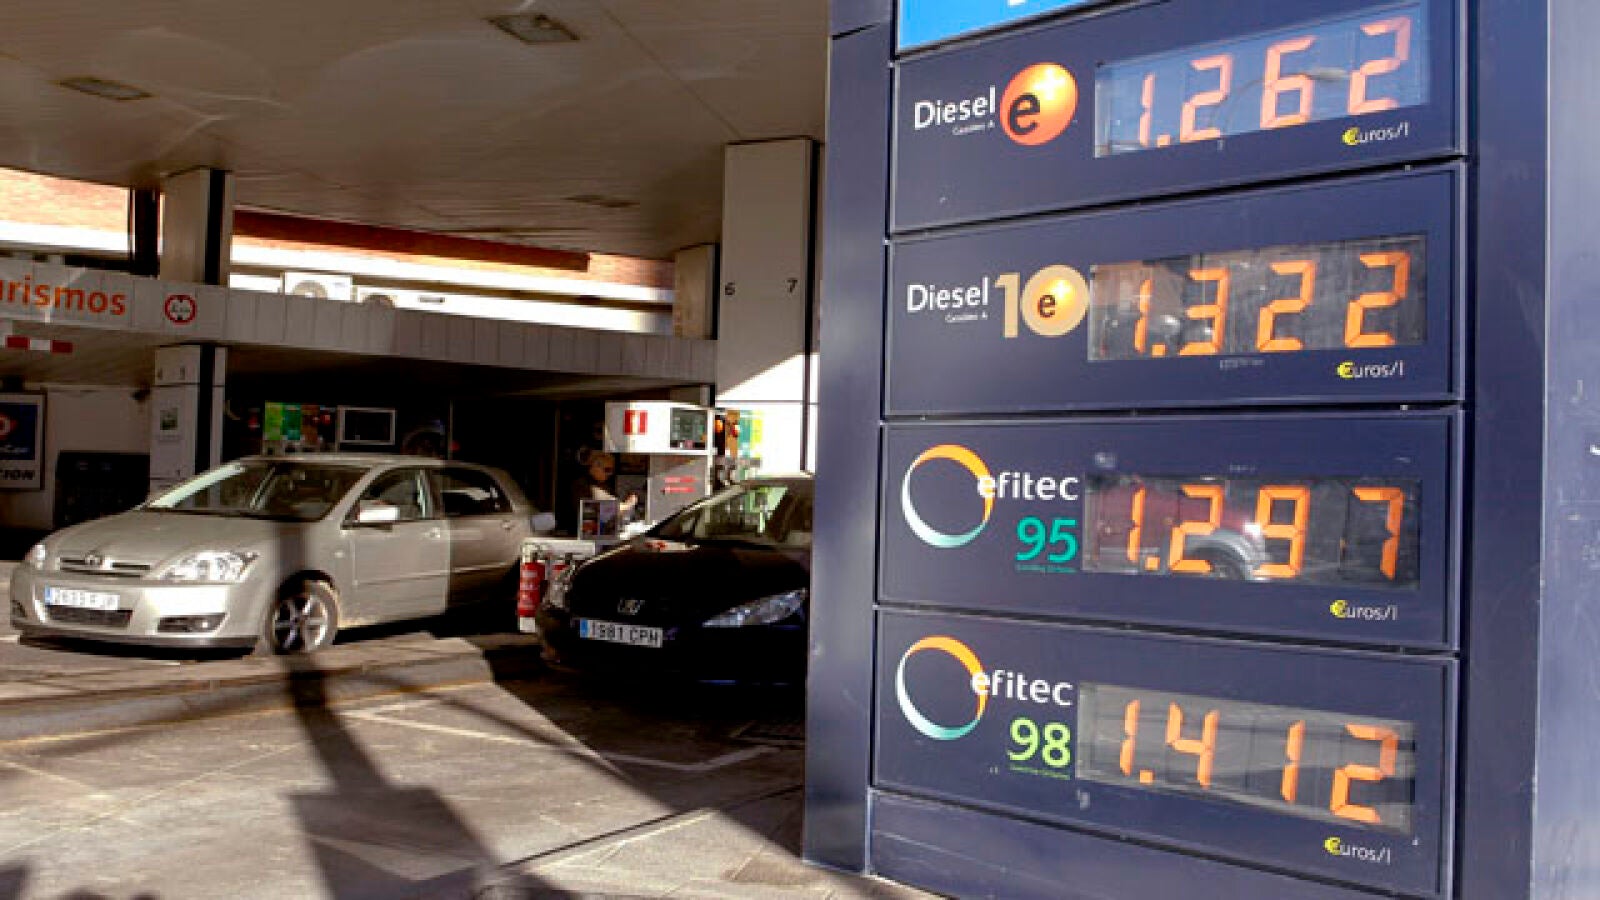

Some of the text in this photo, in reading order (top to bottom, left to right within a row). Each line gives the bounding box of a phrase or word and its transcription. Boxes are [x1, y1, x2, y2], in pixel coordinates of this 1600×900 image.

[1139, 17, 1411, 147] 1.262
[914, 85, 1042, 136] Diesel e
[786, 277, 799, 293] 7
[907, 277, 989, 313] Diesel
[1135, 251, 1410, 357] 1.322
[977, 471, 1080, 501] efitec
[1015, 516, 1080, 564] 95
[1126, 484, 1405, 580] 1.297
[970, 669, 1073, 706] efitec
[1007, 716, 1072, 769] 98
[1119, 699, 1399, 824] 1.412
